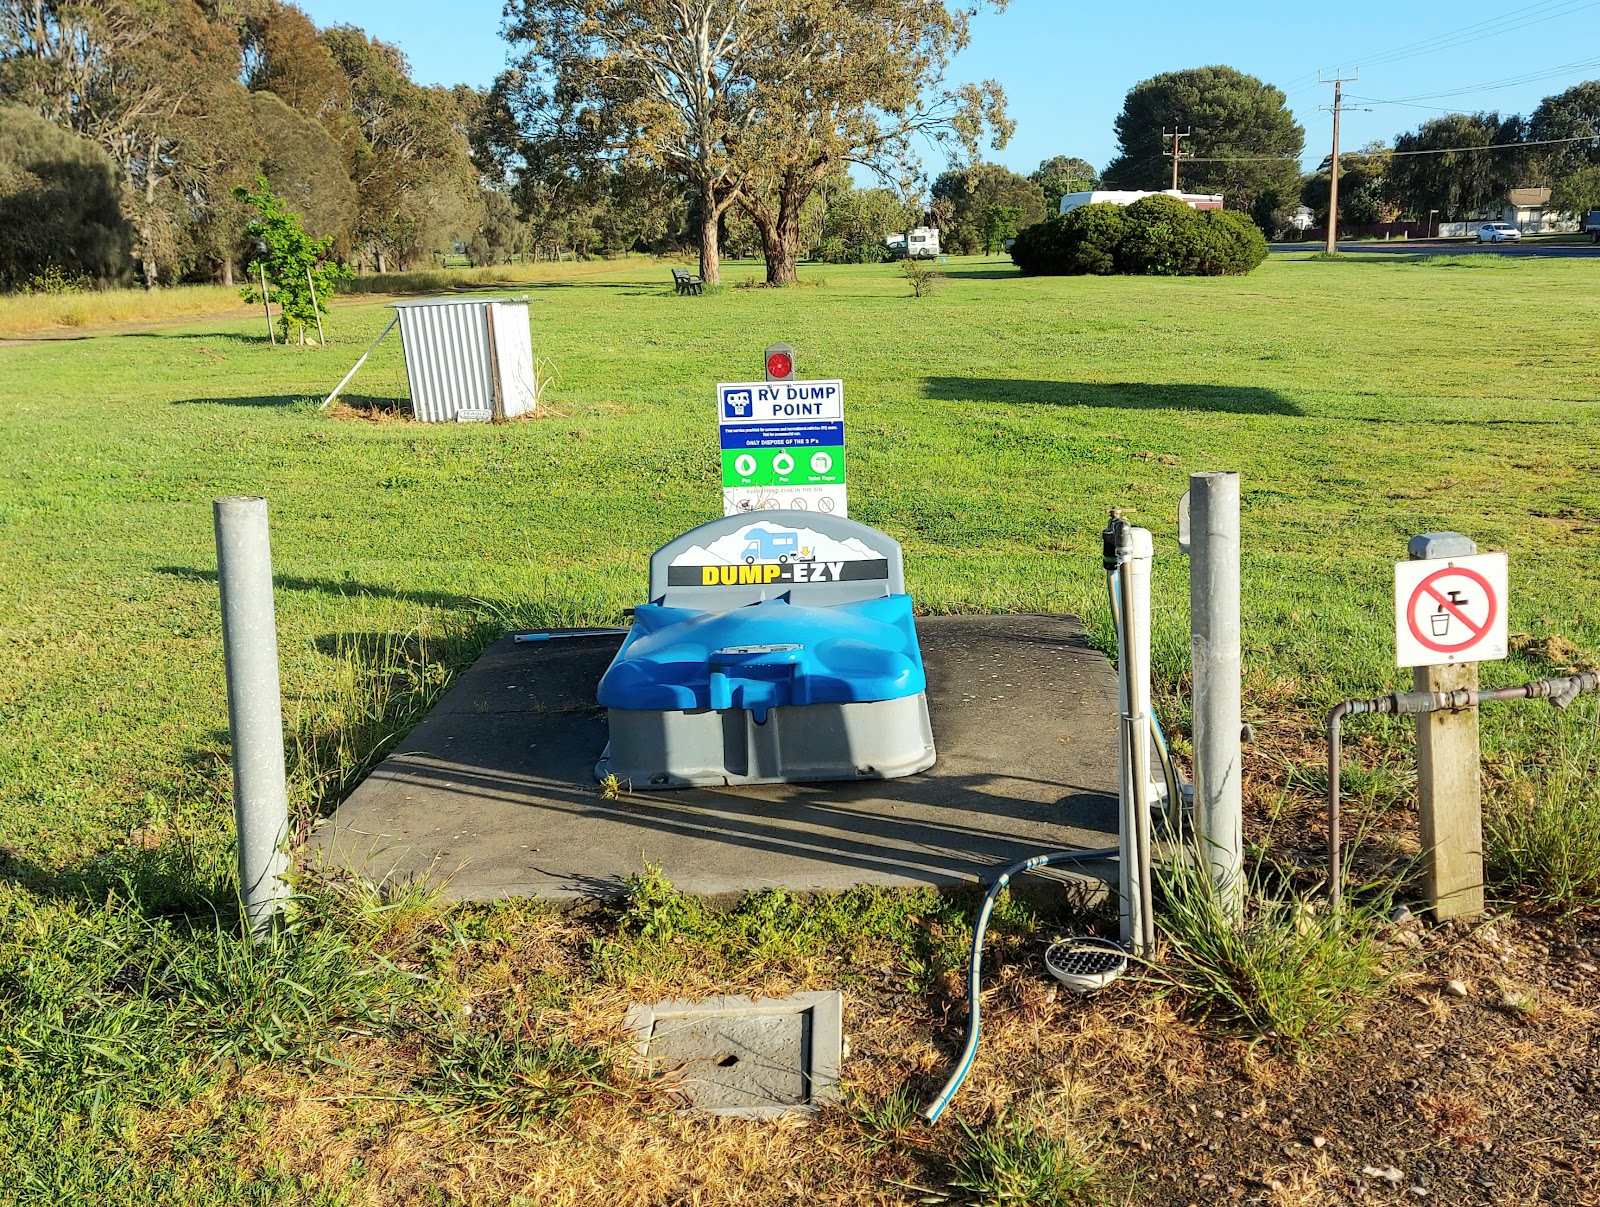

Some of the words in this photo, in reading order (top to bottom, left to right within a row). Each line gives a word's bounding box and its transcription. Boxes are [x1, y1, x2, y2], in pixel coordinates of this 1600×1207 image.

[758, 388, 780, 401] RV
[787, 386, 836, 400] DUMP
[772, 403, 823, 416] POINT
[702, 562, 844, 585] DUMP-EZY
